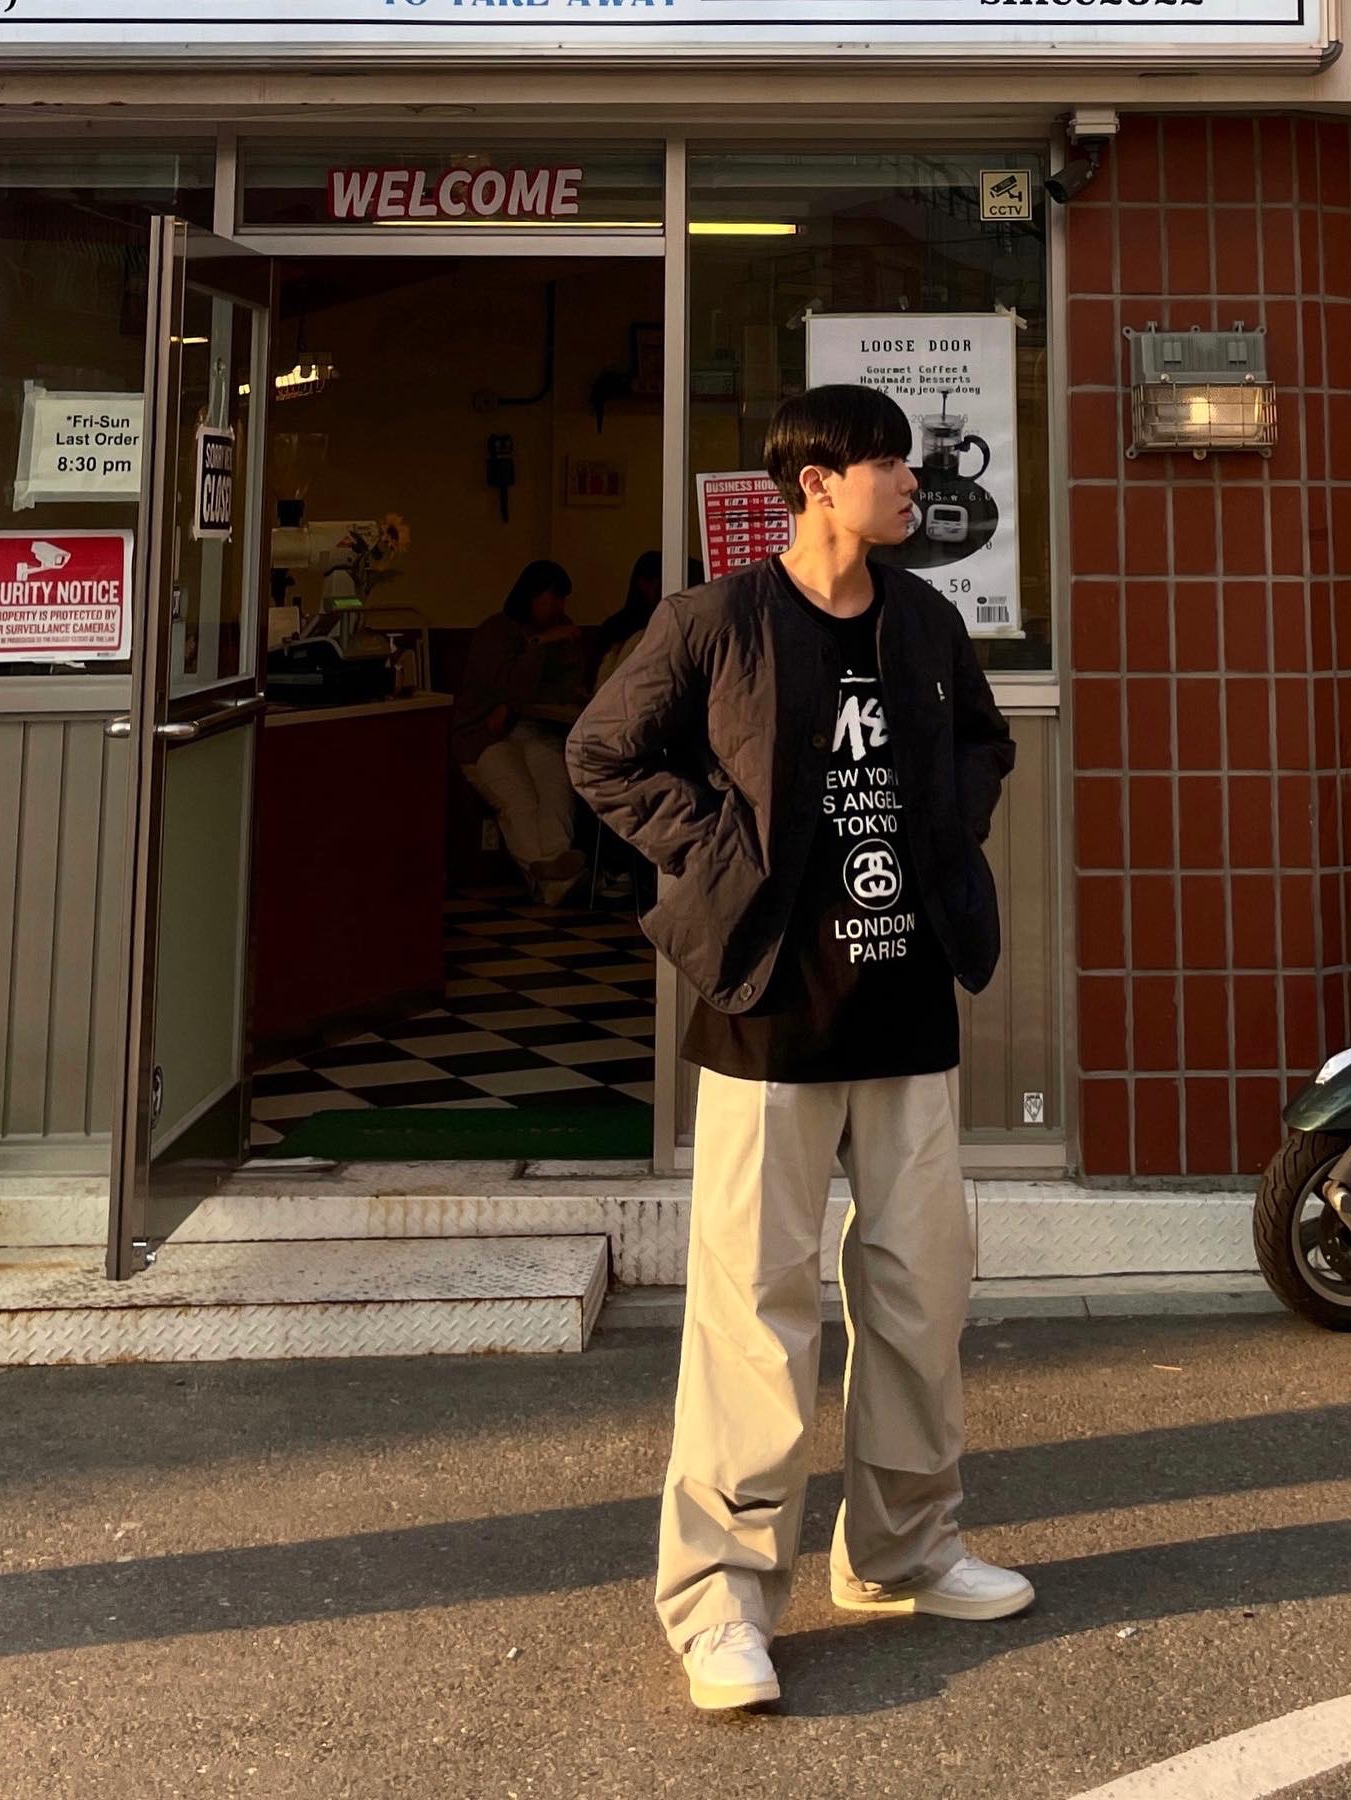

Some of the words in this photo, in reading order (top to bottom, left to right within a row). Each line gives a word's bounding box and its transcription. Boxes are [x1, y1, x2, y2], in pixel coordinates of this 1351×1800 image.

[331, 167, 584, 218] WELCOME
[989, 205, 1022, 216] CCTV
[860, 339, 915, 353] LOOSE
[929, 339, 972, 352] DOOR
[860, 375, 912, 384] Handmade
[920, 375, 971, 384] Desserts
[866, 365, 911, 374] Gourmet
[919, 365, 958, 374] Coffee
[56, 432, 90, 446] Last
[95, 432, 139, 446] Order
[57, 456, 97, 472] 8:30
[103, 460, 132, 476] pm
[705, 480, 752, 494] BUSINESS
[203, 473, 232, 523] CLOSE
[0, 581, 53, 605] URITY
[57, 580, 119, 604] NOTICE
[39, 610, 48, 621] IS
[50, 609, 103, 620] PROTECTED
[105, 609, 117, 620] BY
[5, 624, 70, 635] SURVEILLANCE
[72, 623, 116, 634] CAMERAS
[826, 767, 859, 790] EW
[843, 790, 903, 812] ANGEL
[833, 814, 898, 837] TOKYO
[834, 912, 915, 940] LONDON
[849, 938, 907, 964] PARIS
